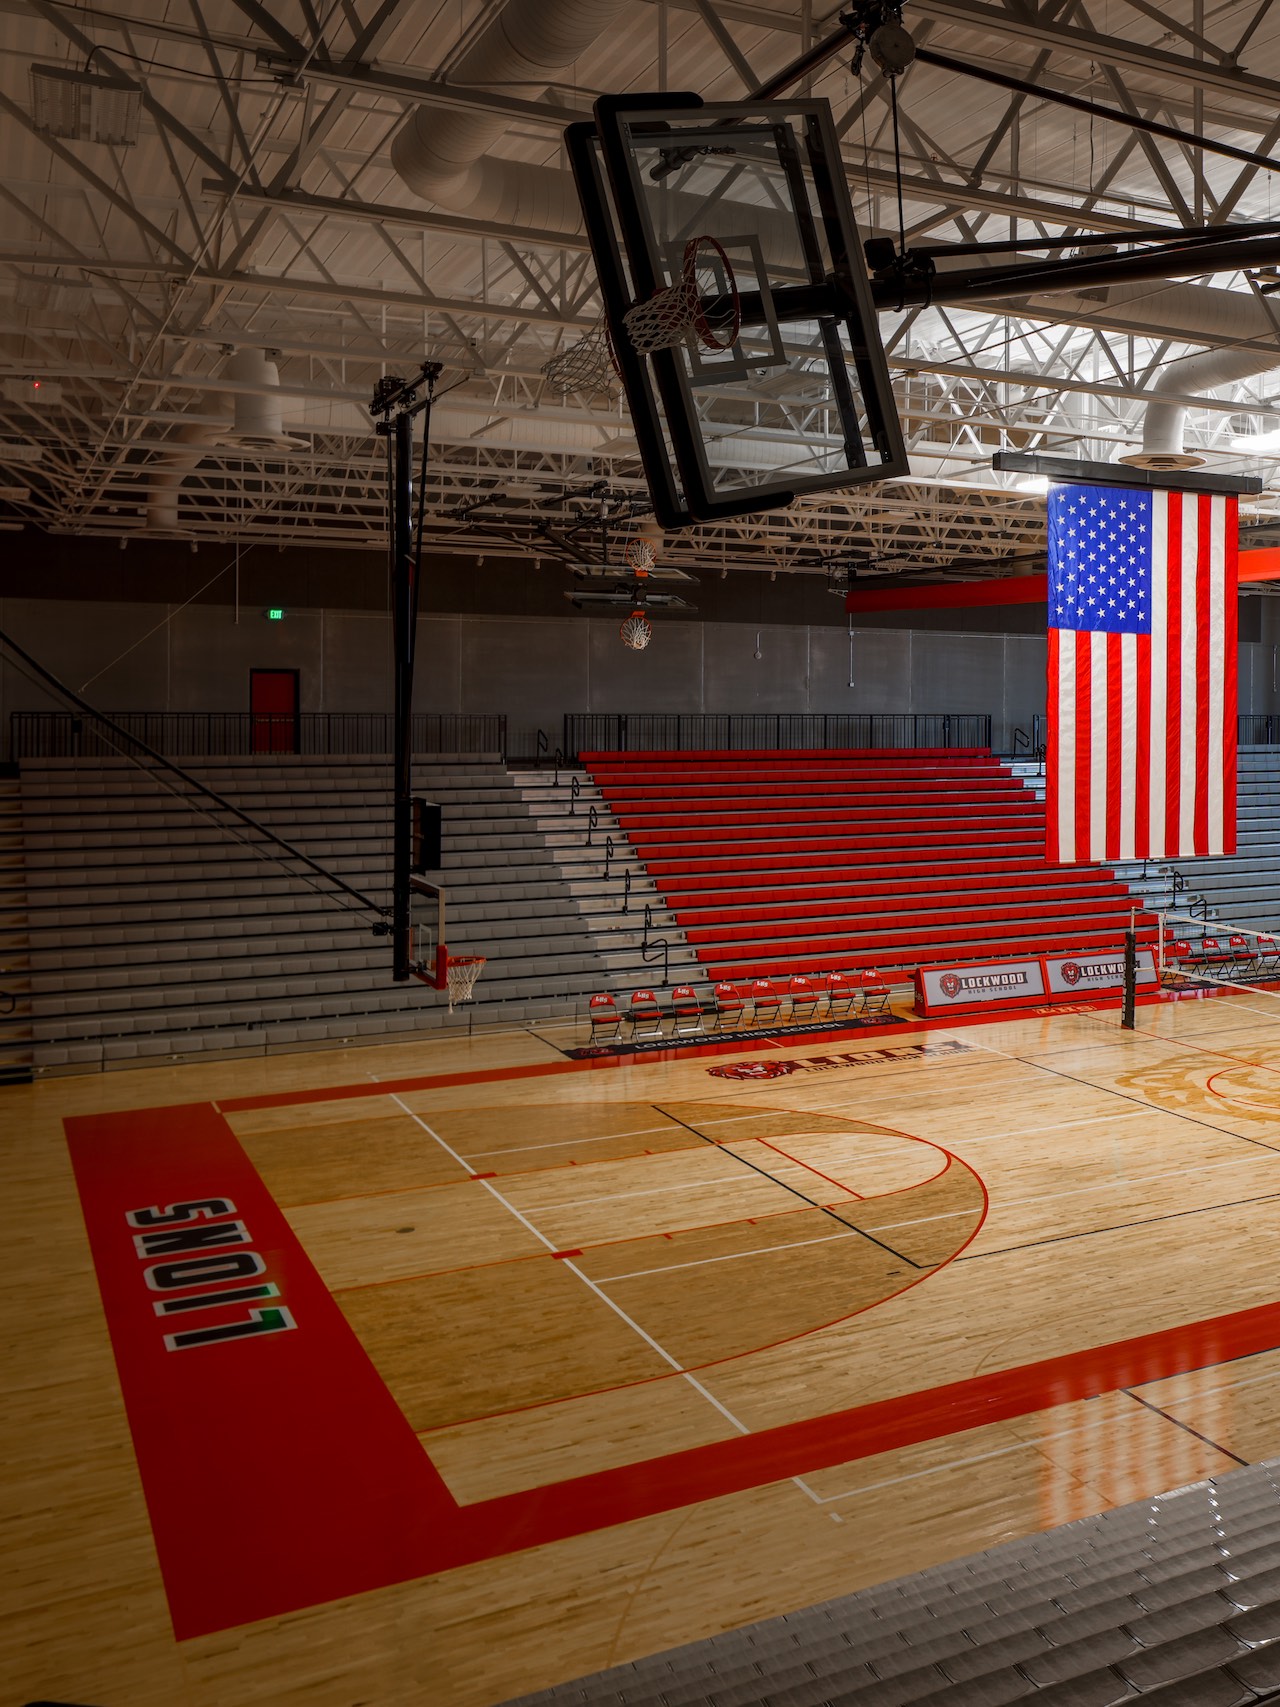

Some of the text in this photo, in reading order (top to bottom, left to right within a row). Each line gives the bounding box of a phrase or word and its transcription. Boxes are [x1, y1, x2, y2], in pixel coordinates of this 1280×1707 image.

[270, 609, 283, 619] EXIT
[1081, 962, 1125, 977] LOCKWO
[961, 973, 1025, 989] LOCKWOOD
[635, 1022, 845, 1050] LOCKWOOD HIGH SCHOOL
[794, 1042, 953, 1068] LIONS
[125, 1197, 298, 1352] LIONS
